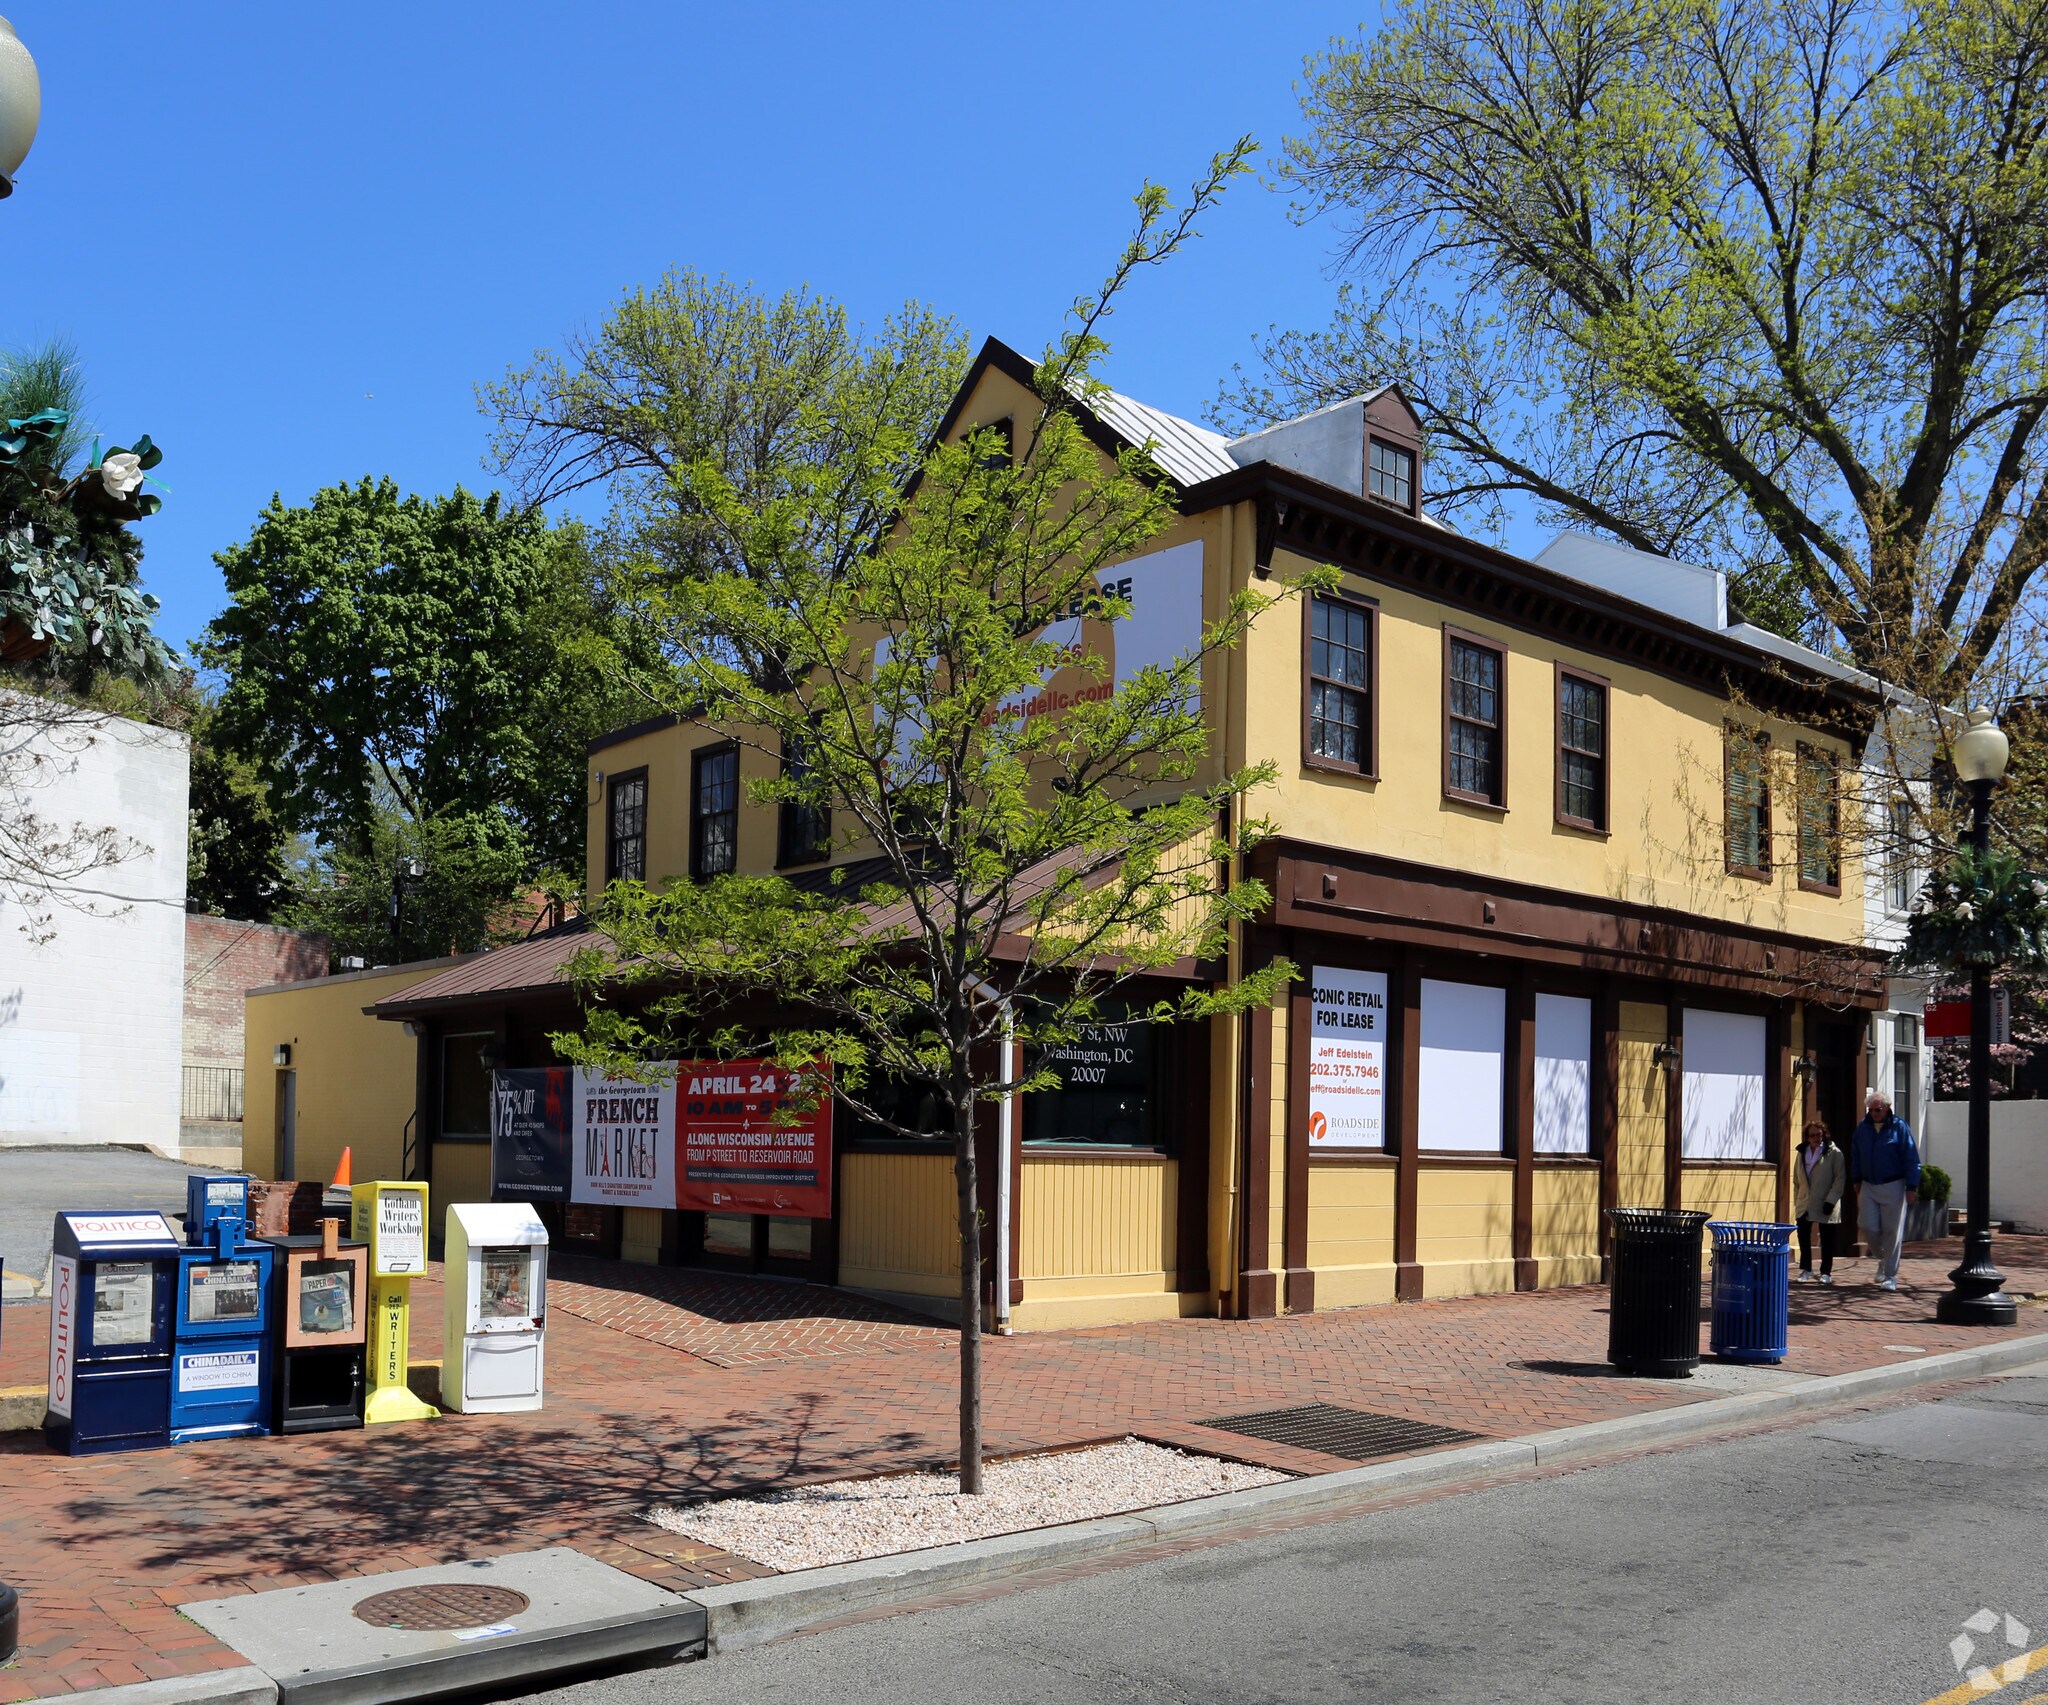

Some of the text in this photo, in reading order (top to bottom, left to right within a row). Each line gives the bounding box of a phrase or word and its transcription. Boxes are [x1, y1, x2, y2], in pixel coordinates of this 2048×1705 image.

[1312, 988, 1383, 1009] CONIC RETAIL
[1925, 1004, 1937, 1012] G2
[1317, 1010, 1374, 1030] FOR LEASE
[1104, 1026, 1128, 1043] NW
[1114, 1047, 1134, 1064] DC
[1318, 1047, 1373, 1060] Jeff Edelstein
[1071, 1066, 1106, 1084] 20007
[1310, 1063, 1379, 1079] 202.375.7946
[598, 1085, 646, 1097] the Georgetown
[688, 1077, 746, 1094] APRIL
[749, 1075, 776, 1093] 24
[1310, 1084, 1381, 1096] eff@roadsidellc.com
[523, 1089, 535, 1115] OFF
[688, 1102, 704, 1115] 10
[708, 1101, 744, 1114] AM
[760, 1101, 772, 1114] 5
[586, 1097, 659, 1124] FRENCH
[1331, 1117, 1379, 1129] ROADSIDE
[687, 1133, 815, 1146] ALONG WISCONSIN AVENUE
[585, 1127, 659, 1179] MARKET
[687, 1149, 814, 1164] FROM P STREET TO RESERVOIR ROAD
[498, 1183, 563, 1192] WWW.GEORGETOWNDC.COM
[385, 1196, 418, 1209] Gotham
[74, 1221, 162, 1232] POLITICO
[380, 1222, 422, 1237] Workshop
[102, 1264, 135, 1273] POLITICO
[308, 1278, 328, 1290] PAPER
[55, 1266, 70, 1402] POLITICO
[389, 1312, 400, 1380] WRITERS
[192, 1373, 220, 1381] WINDOW
[232, 1371, 252, 1379] CHINA
